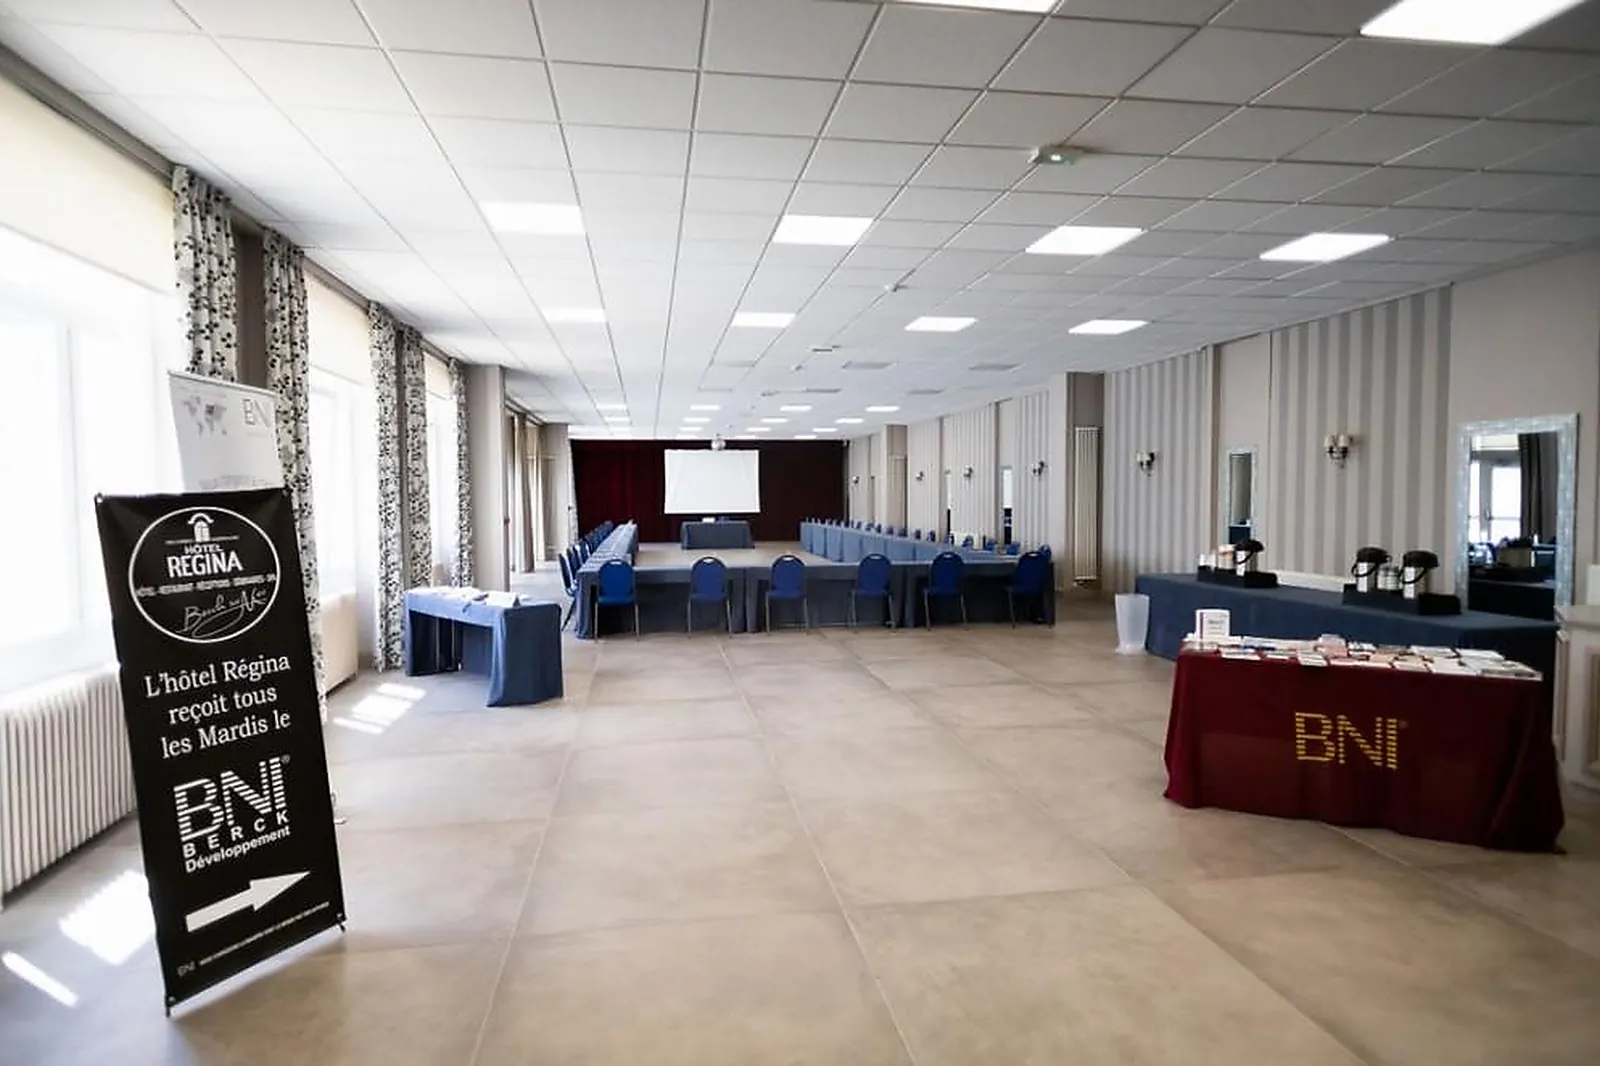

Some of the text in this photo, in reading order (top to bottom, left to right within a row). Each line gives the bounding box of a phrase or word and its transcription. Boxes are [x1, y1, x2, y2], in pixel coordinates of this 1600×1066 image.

[167, 550, 244, 578] REGINA
[144, 654, 291, 697] L'hôtel Régina
[168, 686, 278, 724] reçoit tous
[161, 709, 291, 759] les Mardis le
[1295, 712, 1398, 770] BNI
[173, 756, 287, 842] BNI
[182, 810, 289, 858] BERCK
[185, 825, 291, 874] Développement
